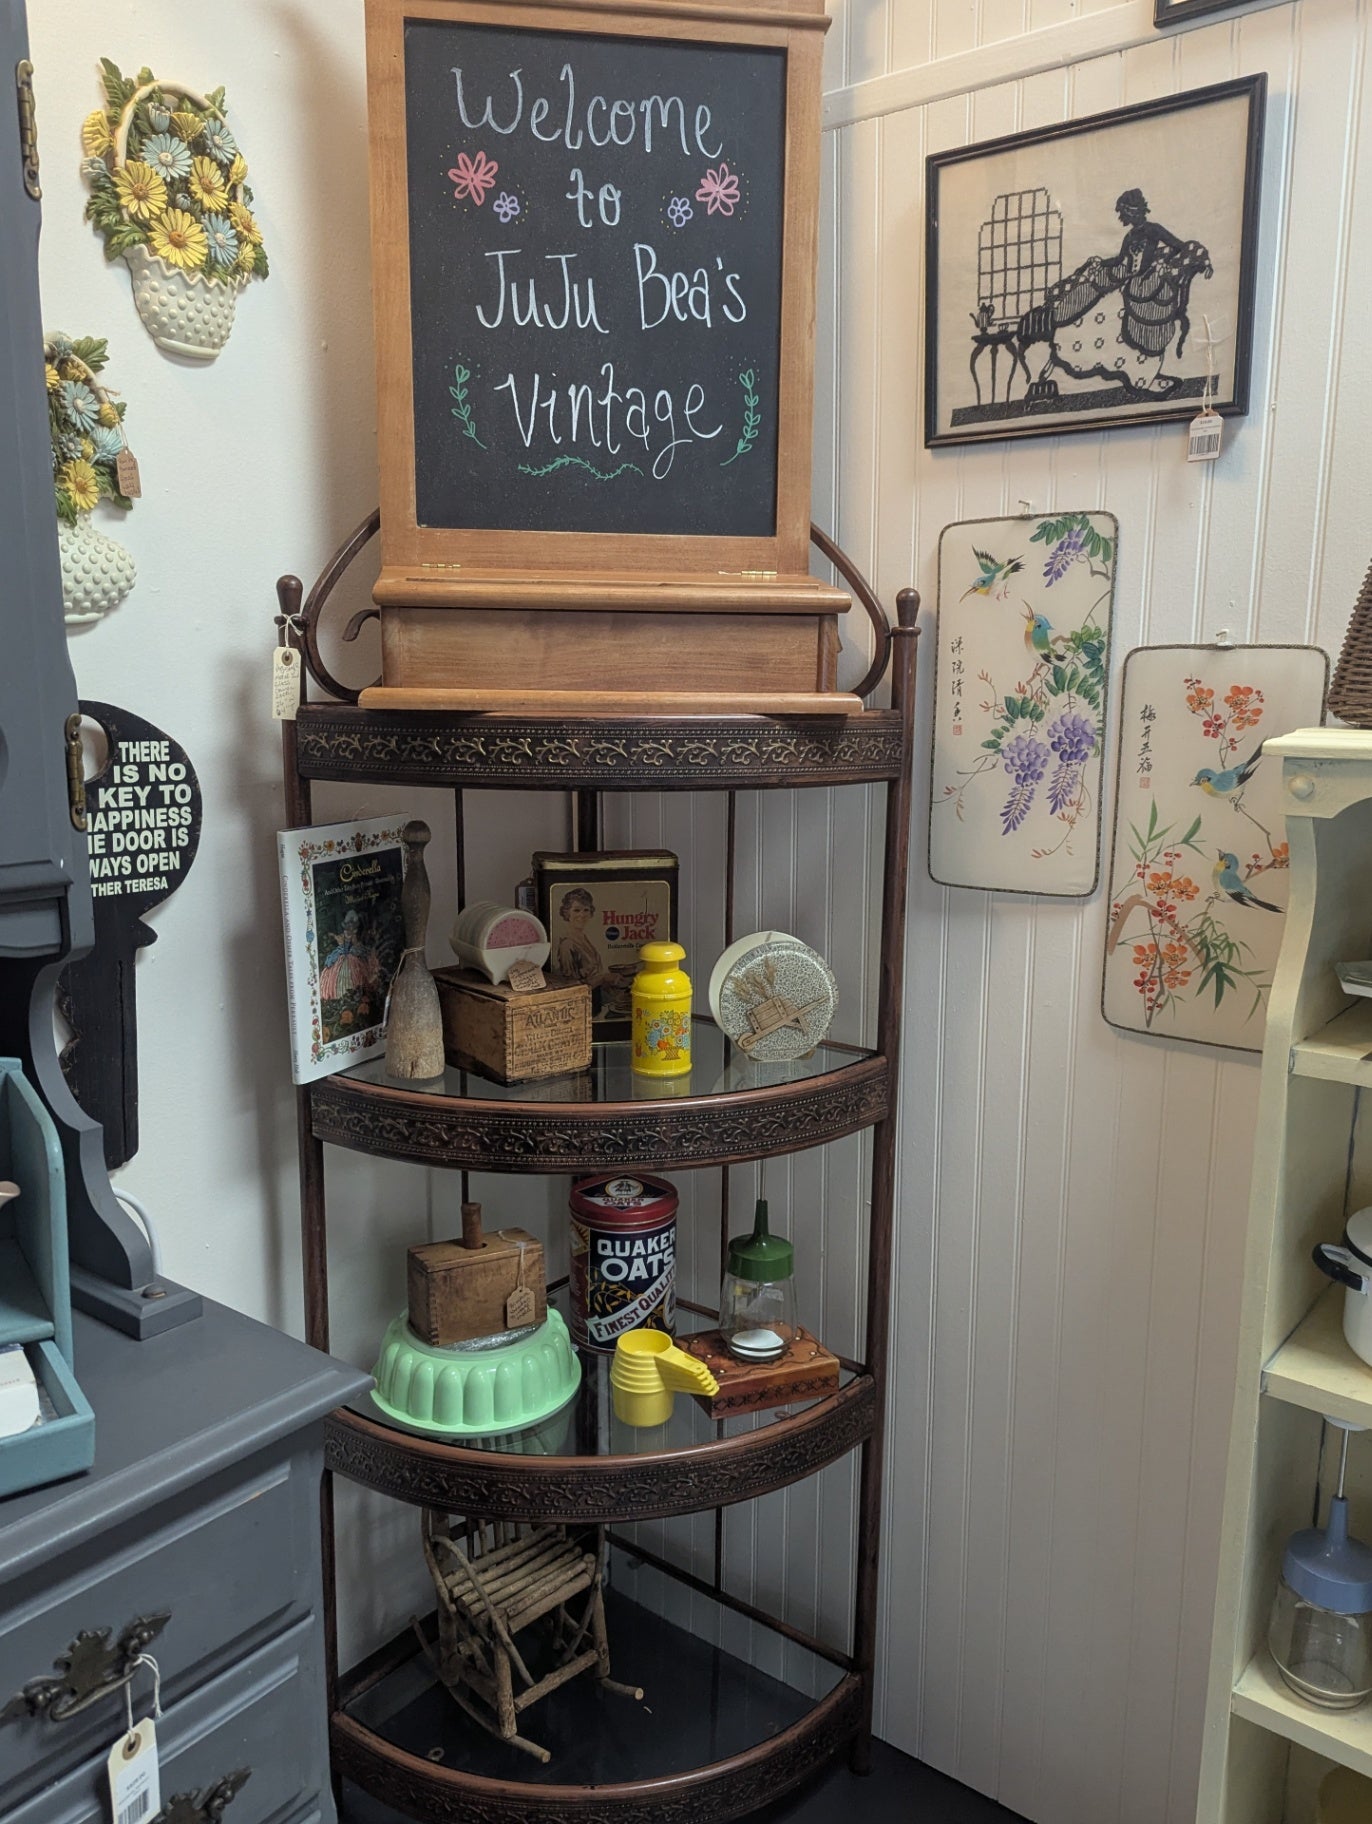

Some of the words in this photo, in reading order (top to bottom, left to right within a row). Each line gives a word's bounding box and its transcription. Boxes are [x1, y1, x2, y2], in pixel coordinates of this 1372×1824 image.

[450, 63, 723, 158] Welcome
[566, 168, 621, 227] to
[476, 249, 609, 333] JuJu
[634, 243, 746, 330] Bea's
[494, 363, 723, 479] Vintage
[118, 740, 170, 763] THERE
[113, 765, 140, 783] IS
[149, 763, 187, 782] NO
[98, 786, 151, 808] KEY
[159, 783, 192, 805] TO
[112, 830, 166, 853] DOOR
[171, 827, 189, 847] IS
[89, 856, 132, 878] WAYS
[137, 851, 180, 873] OPEN
[340, 859, 381, 882] Cinderella
[91, 881, 123, 898] THER
[124, 876, 168, 894] TERESA
[602, 911, 659, 927] Hungry
[621, 925, 656, 940] Jack
[596, 1226, 676, 1257] QUAKER
[601, 1246, 675, 1282] OATS
[594, 1308, 640, 1338] FINEST
